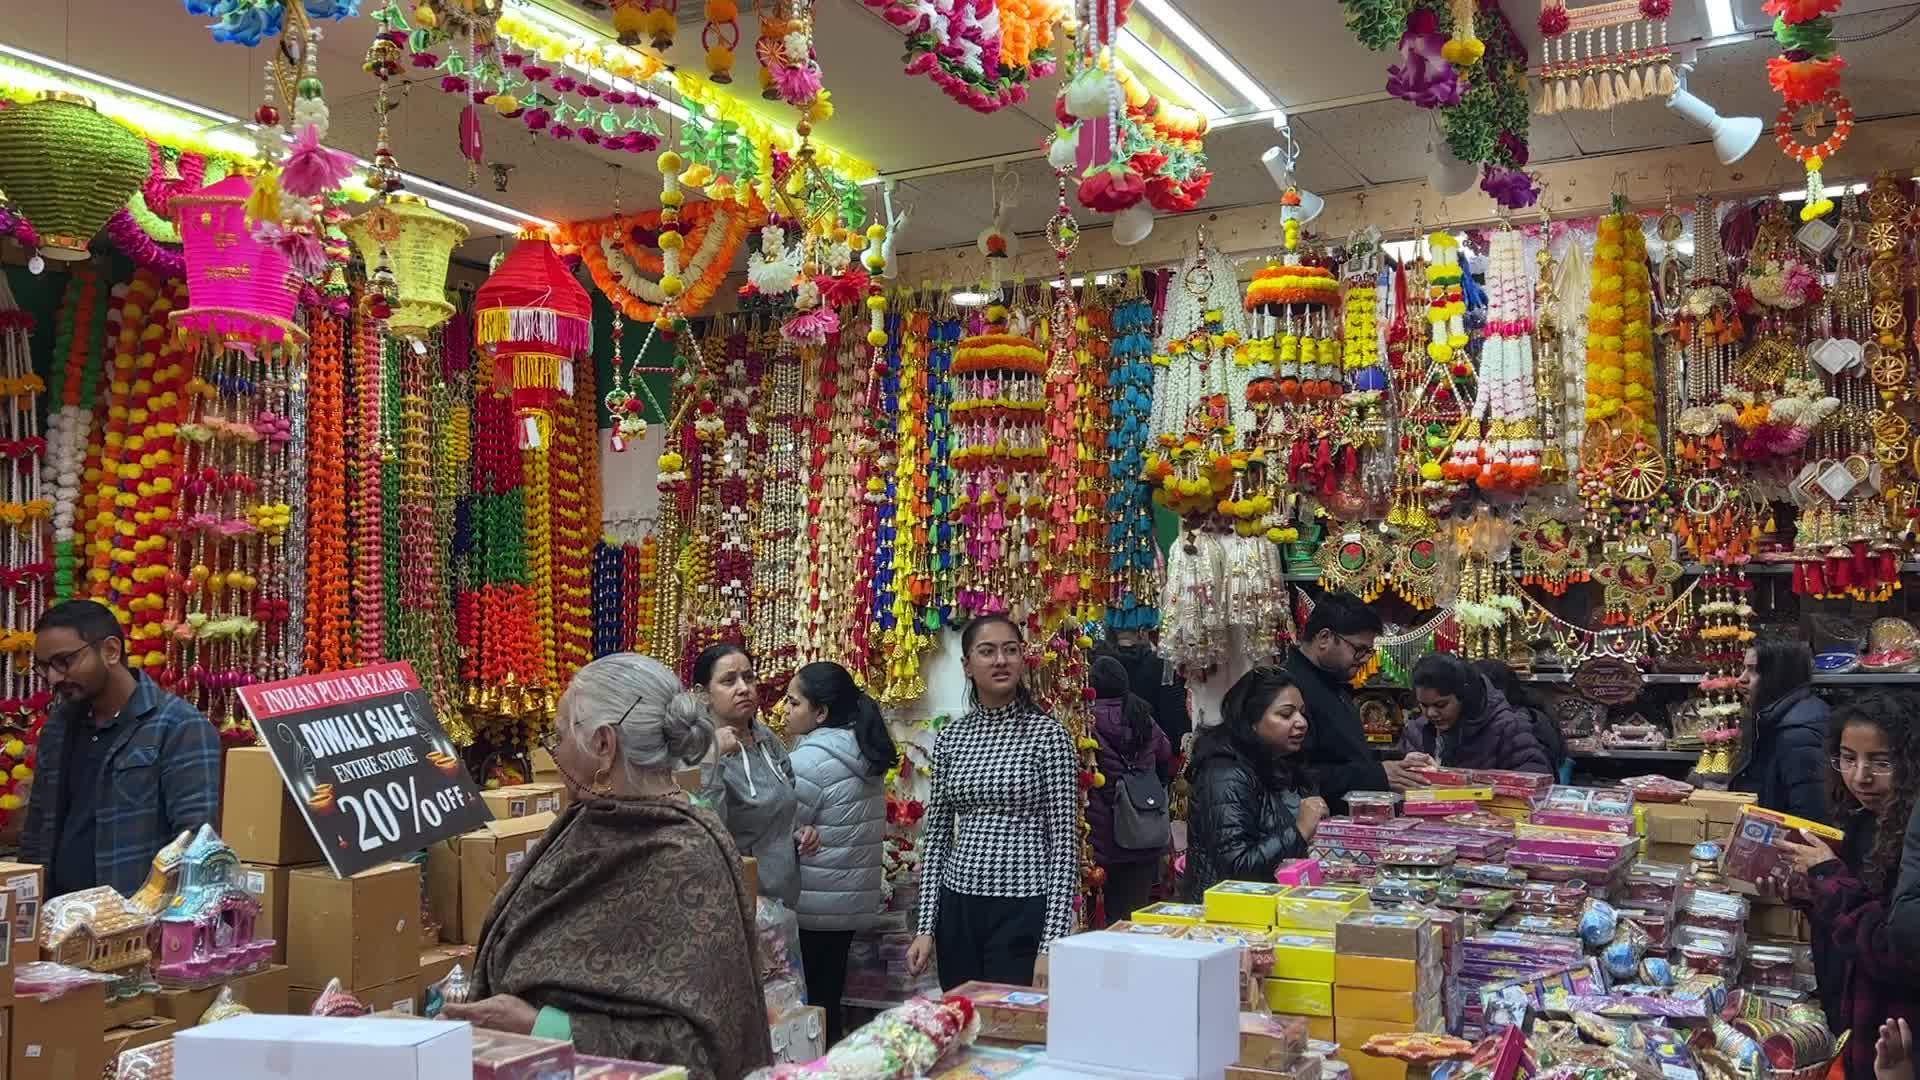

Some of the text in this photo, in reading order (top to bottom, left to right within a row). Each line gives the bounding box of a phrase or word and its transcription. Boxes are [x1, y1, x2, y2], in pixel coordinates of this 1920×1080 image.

[260, 668, 409, 713] INDIAN PUJA BAZAAR
[298, 703, 418, 759] DIWALI SALE
[332, 746, 418, 783] ENTIRE STORE
[337, 776, 465, 852] 20% OFF
